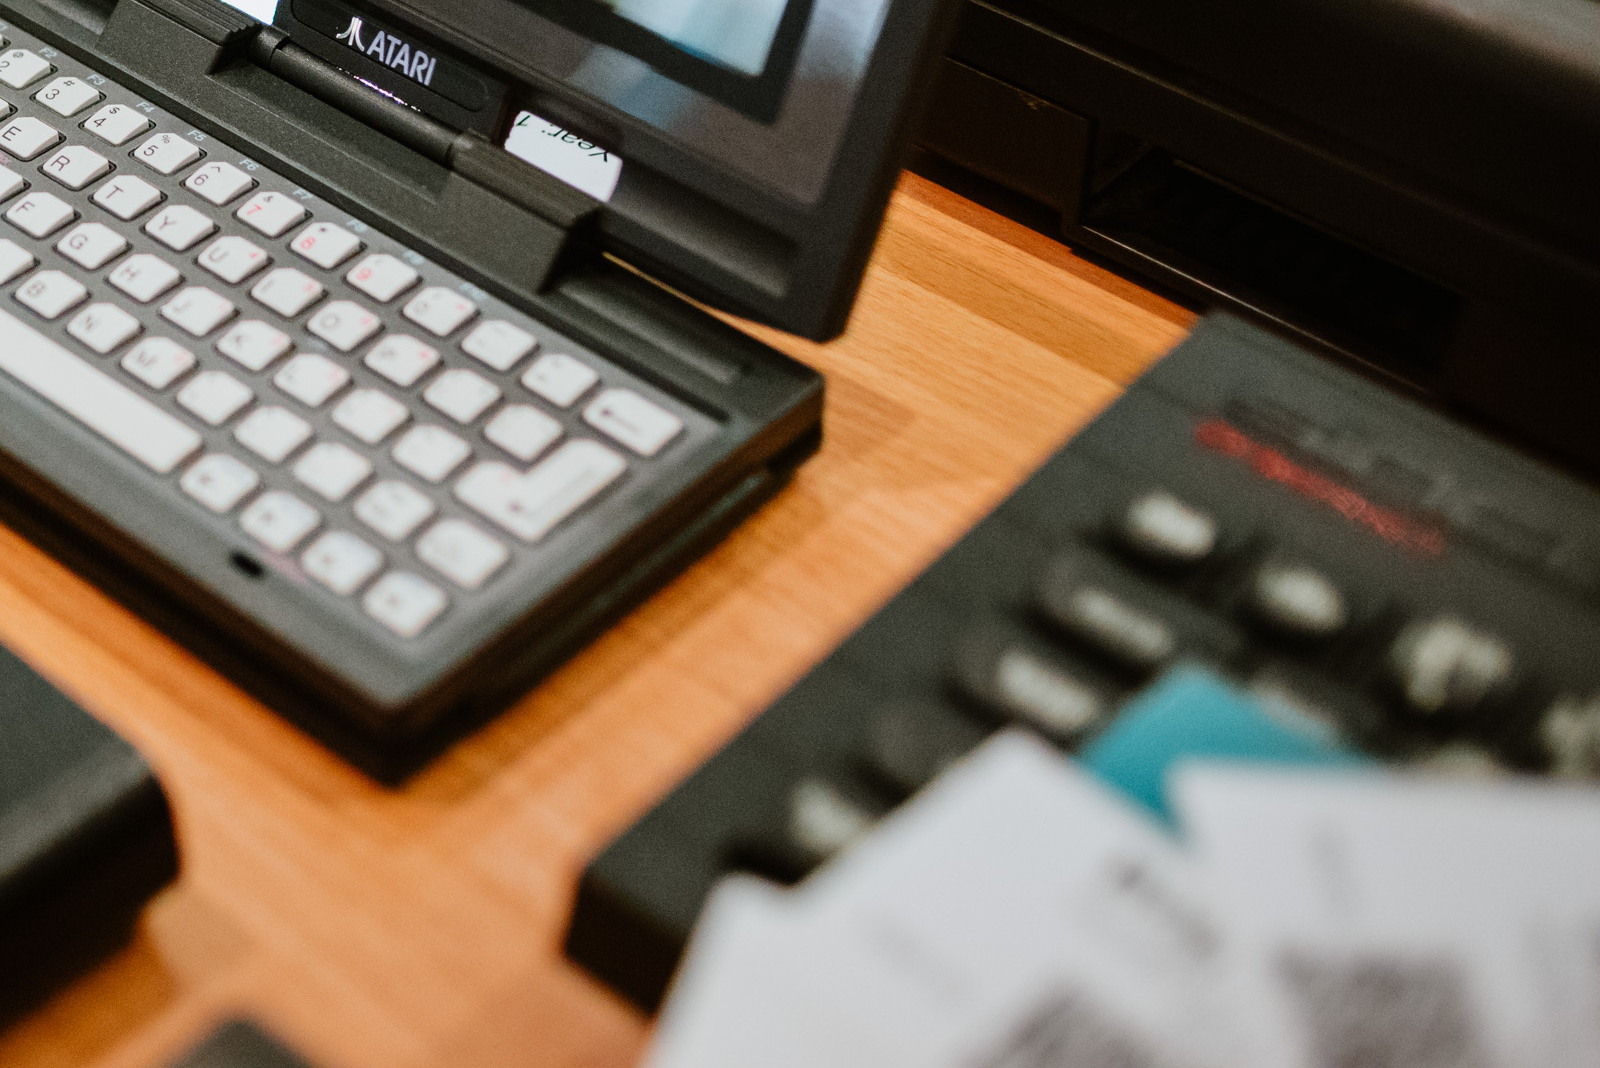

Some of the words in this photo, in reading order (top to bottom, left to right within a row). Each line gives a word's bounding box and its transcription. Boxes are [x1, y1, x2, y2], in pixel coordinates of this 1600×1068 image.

[38, 47, 58, 58] F2
[366, 30, 437, 87] ATARI
[86, 74, 106, 86] F3
[45, 89, 60, 100] 3
[108, 106, 120, 115] $
[136, 101, 155, 113] F4
[93, 117, 107, 128] 4
[1, 125, 22, 142] E
[161, 134, 170, 144] %
[187, 130, 207, 142] F5
[143, 144, 159, 156] 5
[50, 155, 71, 171] R
[239, 158, 259, 171] F6
[194, 174, 209, 186] 6
[105, 184, 124, 199] T
[15, 201, 35, 214] F
[246, 204, 262, 215] 7
[158, 215, 177, 230] Y
[69, 233, 88, 250] G
[300, 236, 316, 250] 8
[208, 246, 229, 262] U
